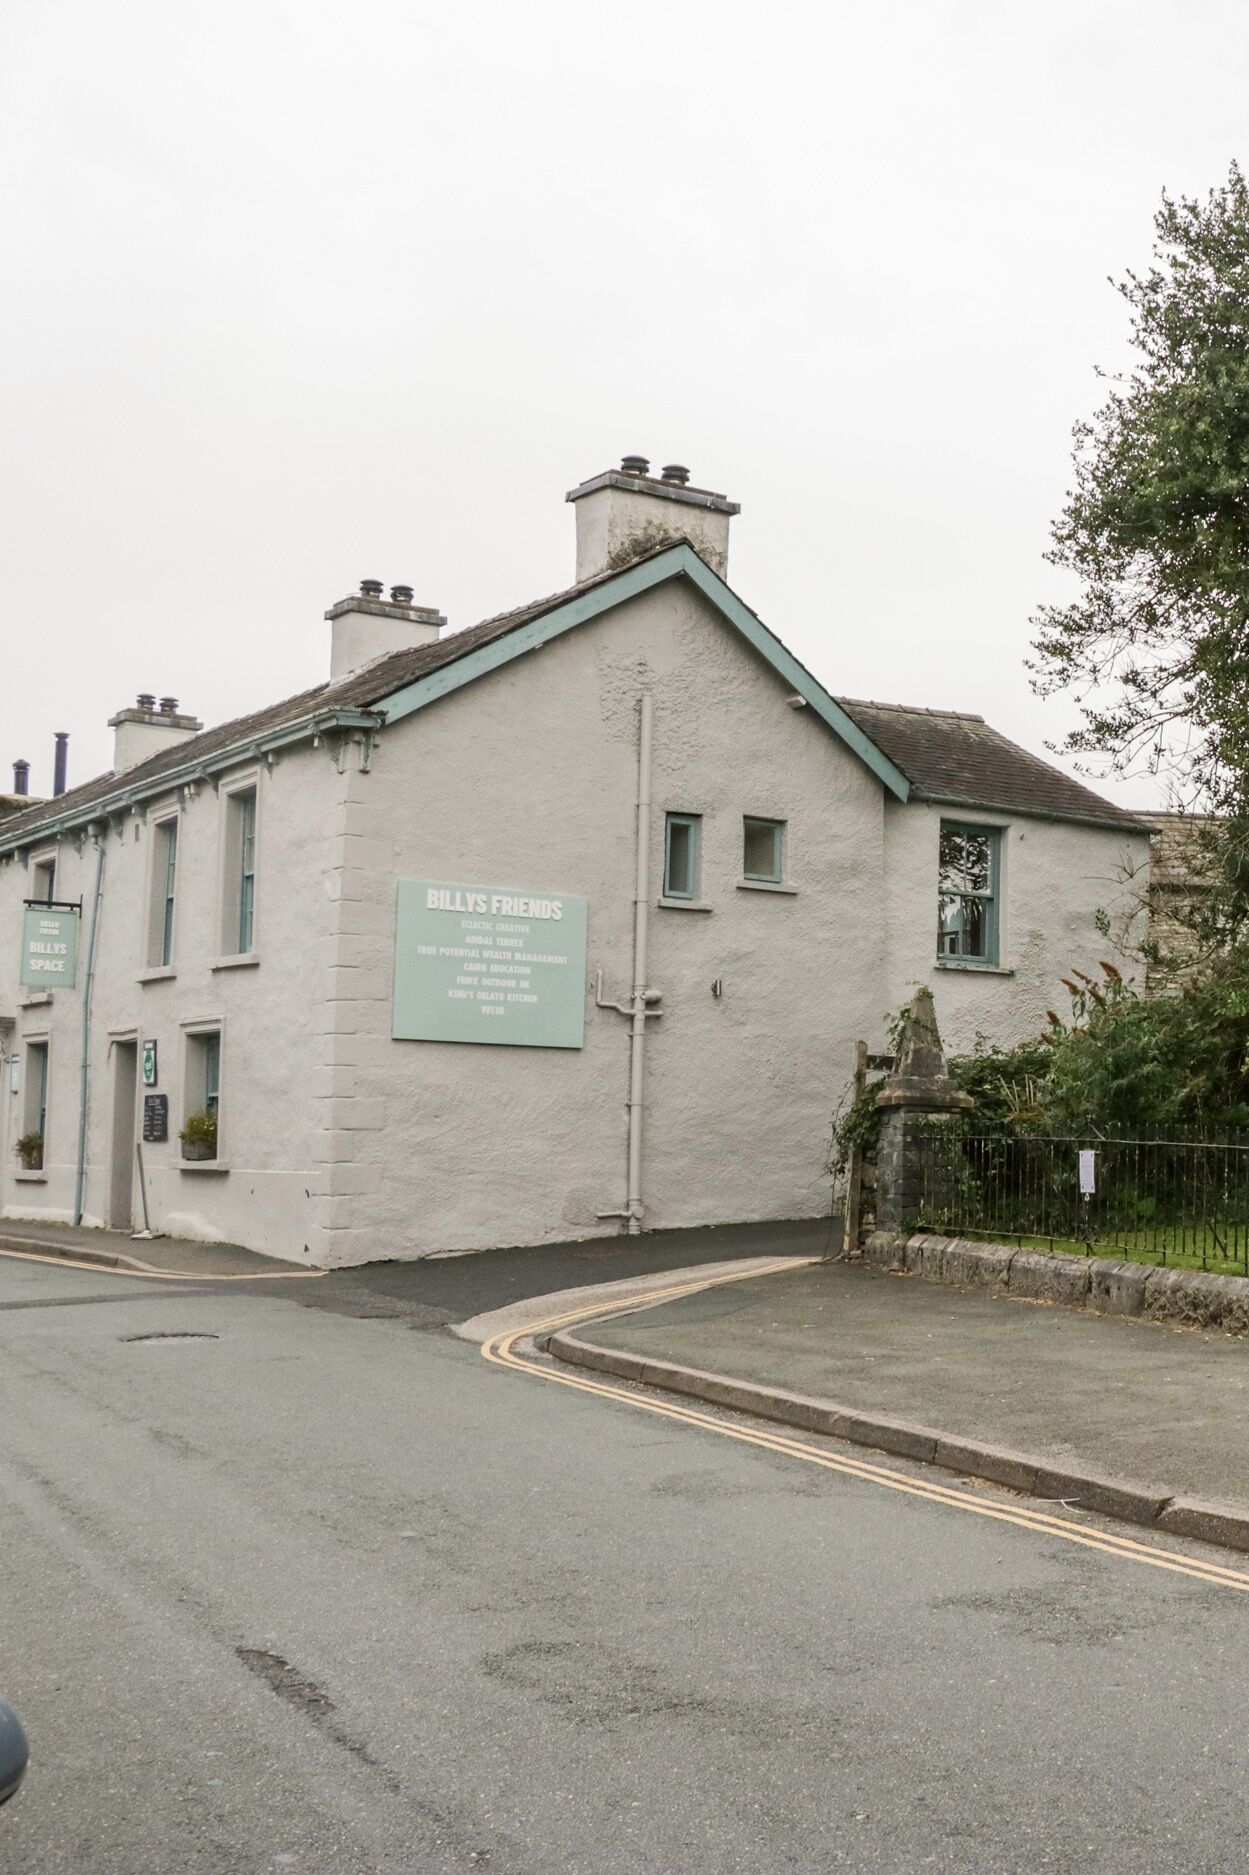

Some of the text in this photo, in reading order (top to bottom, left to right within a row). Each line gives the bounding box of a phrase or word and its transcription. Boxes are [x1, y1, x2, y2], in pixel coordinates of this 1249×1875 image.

[426, 888, 563, 921] BILLYS FRIENDS
[461, 920, 530, 934] ECLECTIC CREATIVE
[465, 935, 524, 947] ADIDAS TERREX
[29, 942, 68, 954] BILLYS
[417, 945, 568, 964] TRUE POTENTIAL WEALTH MANAGEMENT
[30, 959, 65, 972] SPACE
[464, 962, 531, 975] CAIRN EDUCATION
[481, 977, 517, 988] OUTDOOR
[519, 980, 530, 989] UK
[476, 991, 505, 1001] GELATO
[507, 993, 538, 1003] KITCHEN
